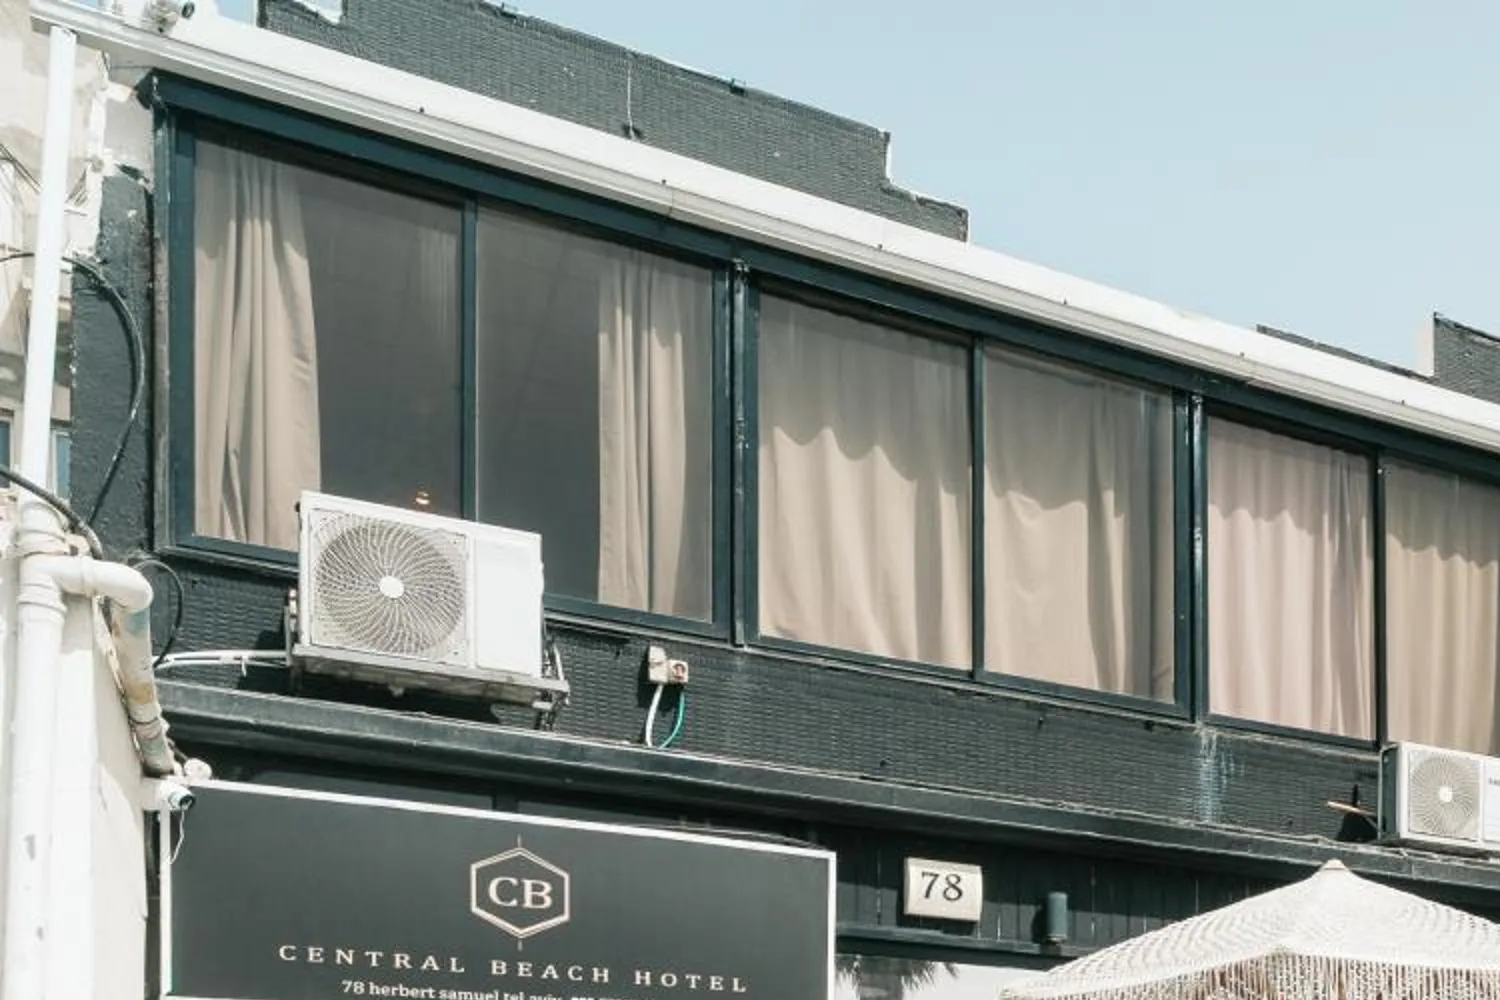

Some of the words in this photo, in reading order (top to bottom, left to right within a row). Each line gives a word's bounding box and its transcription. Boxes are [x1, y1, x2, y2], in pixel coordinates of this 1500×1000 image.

[488, 876, 552, 909] CB
[921, 871, 963, 902] 78
[278, 945, 465, 974] CENTRAL
[490, 959, 610, 984] BEACH
[634, 970, 747, 993] HOTEL
[341, 979, 365, 995] 78
[368, 981, 436, 1000] herbert
